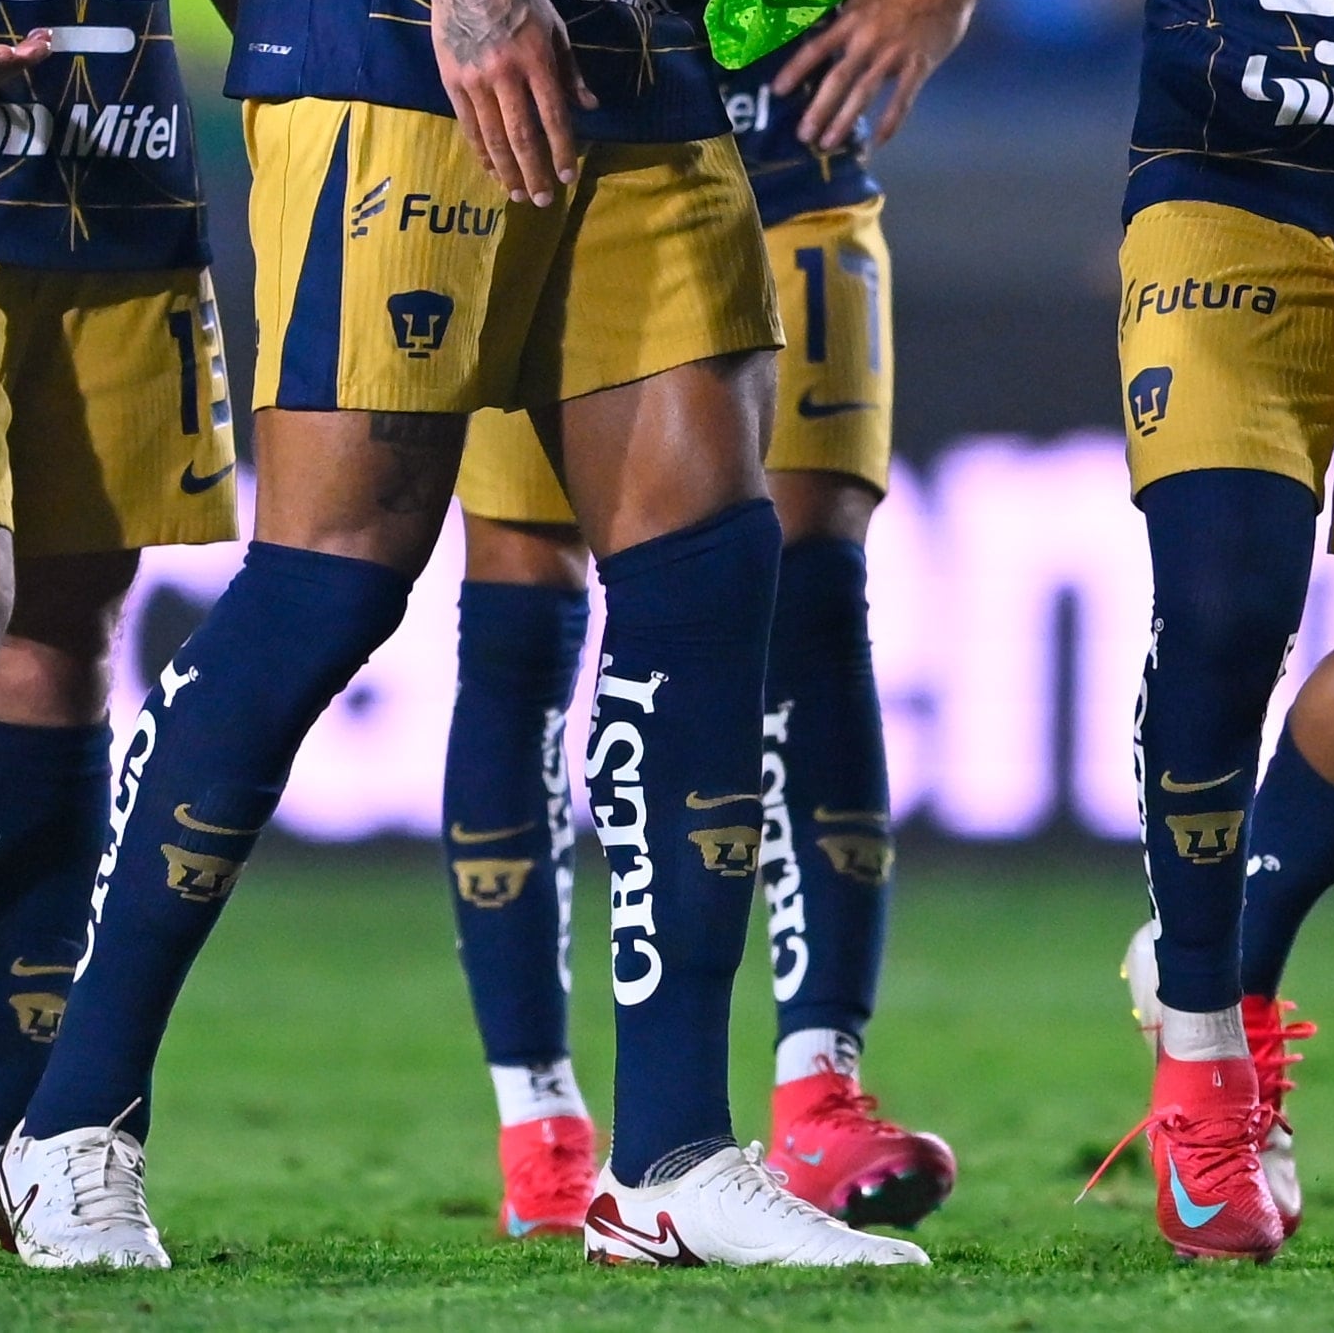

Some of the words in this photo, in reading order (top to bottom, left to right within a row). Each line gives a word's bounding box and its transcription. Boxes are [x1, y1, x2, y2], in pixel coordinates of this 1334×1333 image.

[60, 102, 178, 159] Mifel
[1136, 278, 1277, 324] Futura
[584, 653, 663, 1007] CREST
